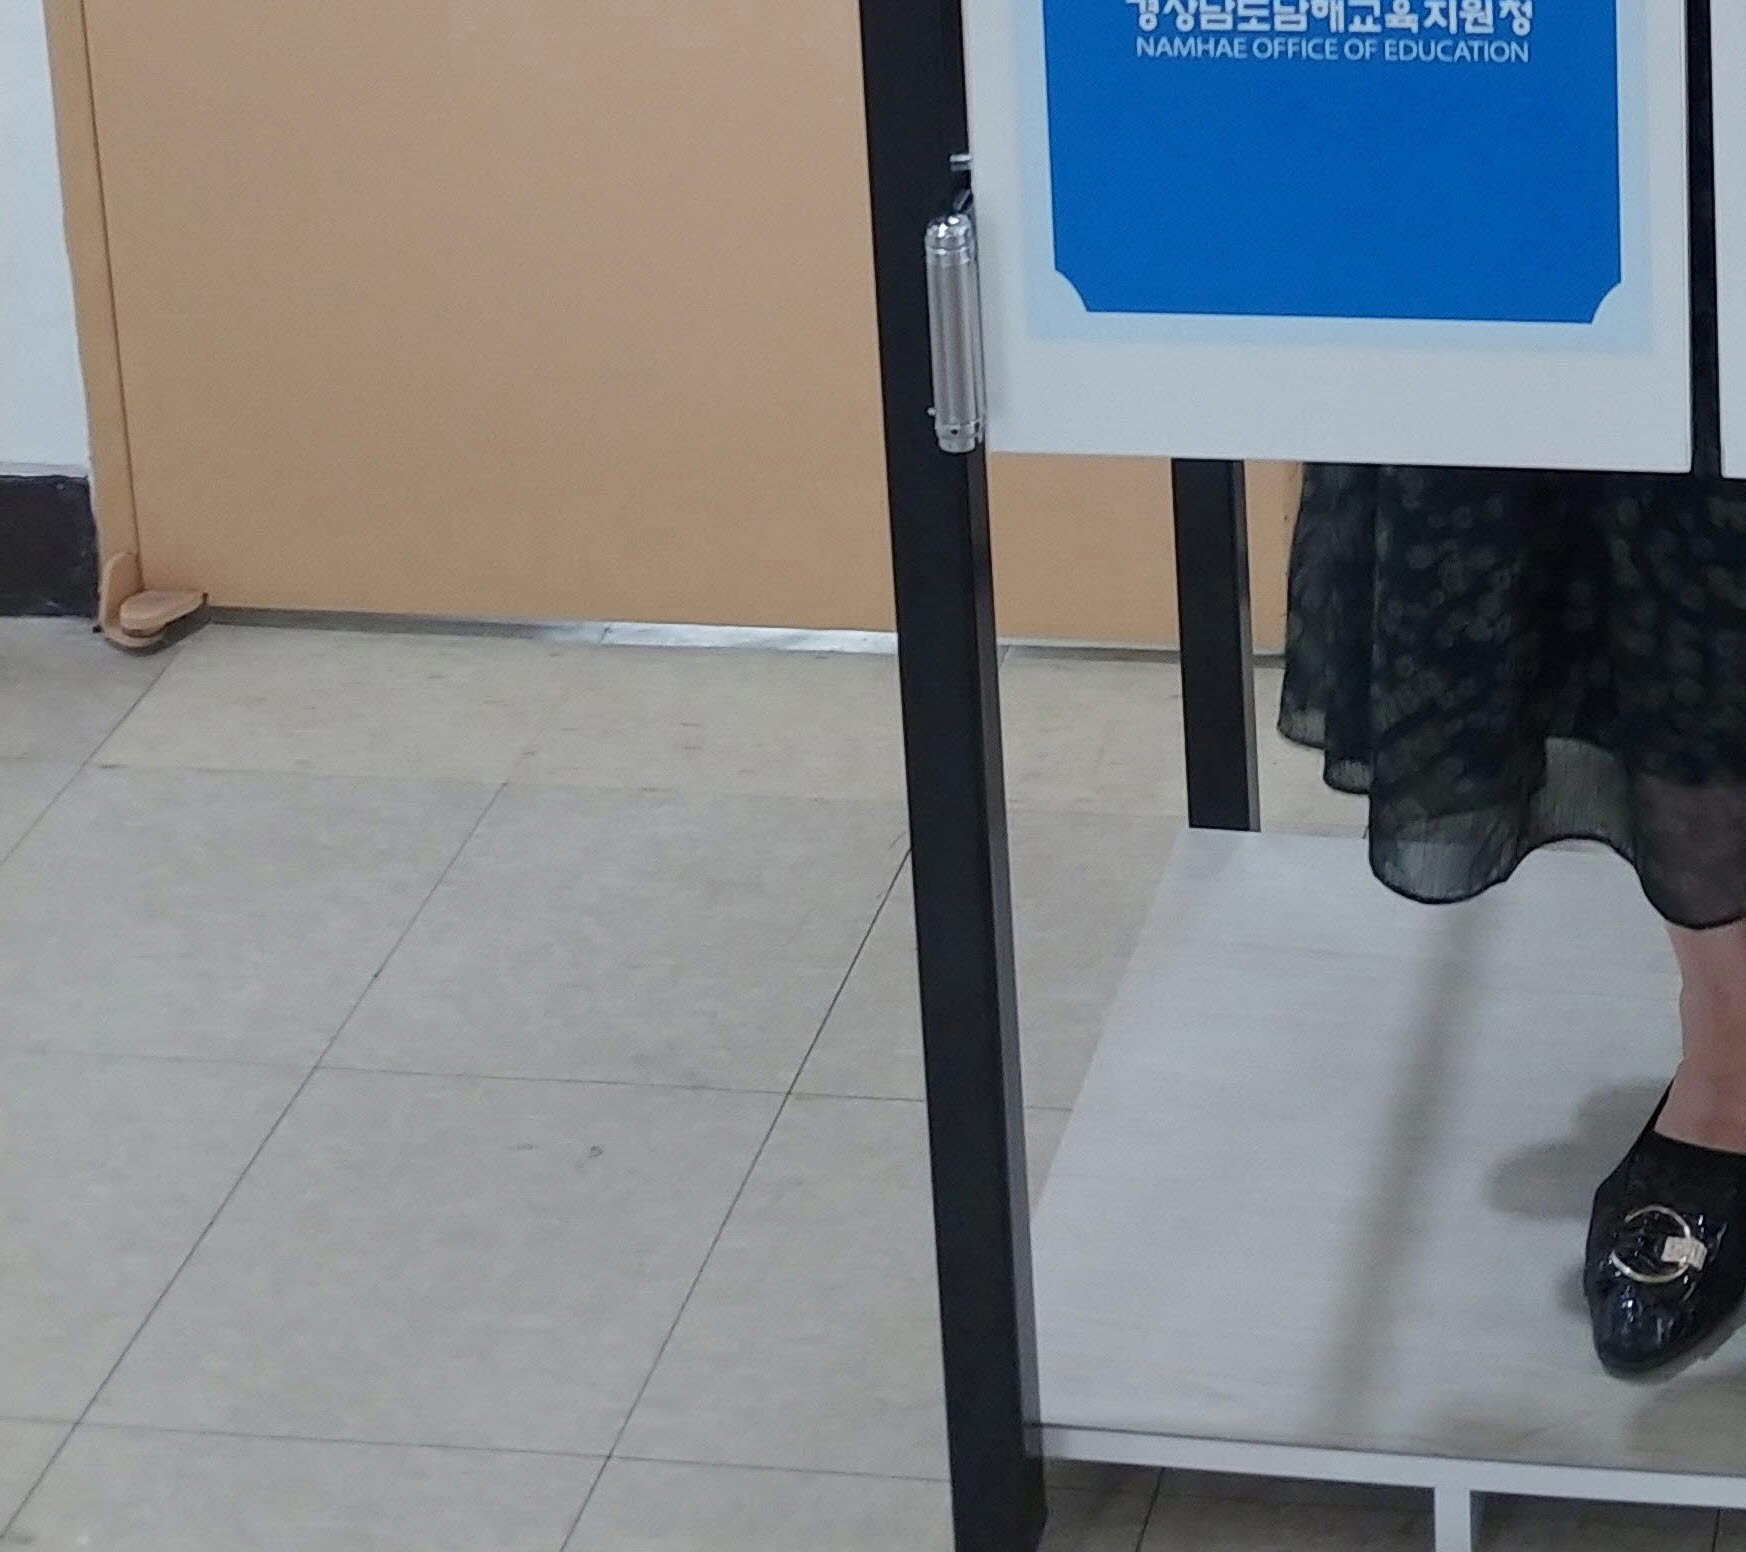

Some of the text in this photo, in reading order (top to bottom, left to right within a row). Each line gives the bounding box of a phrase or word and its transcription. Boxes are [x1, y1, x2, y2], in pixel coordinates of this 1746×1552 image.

[1136, 36, 1529, 64] NAMHAE OFFICE OF EDUCATION
